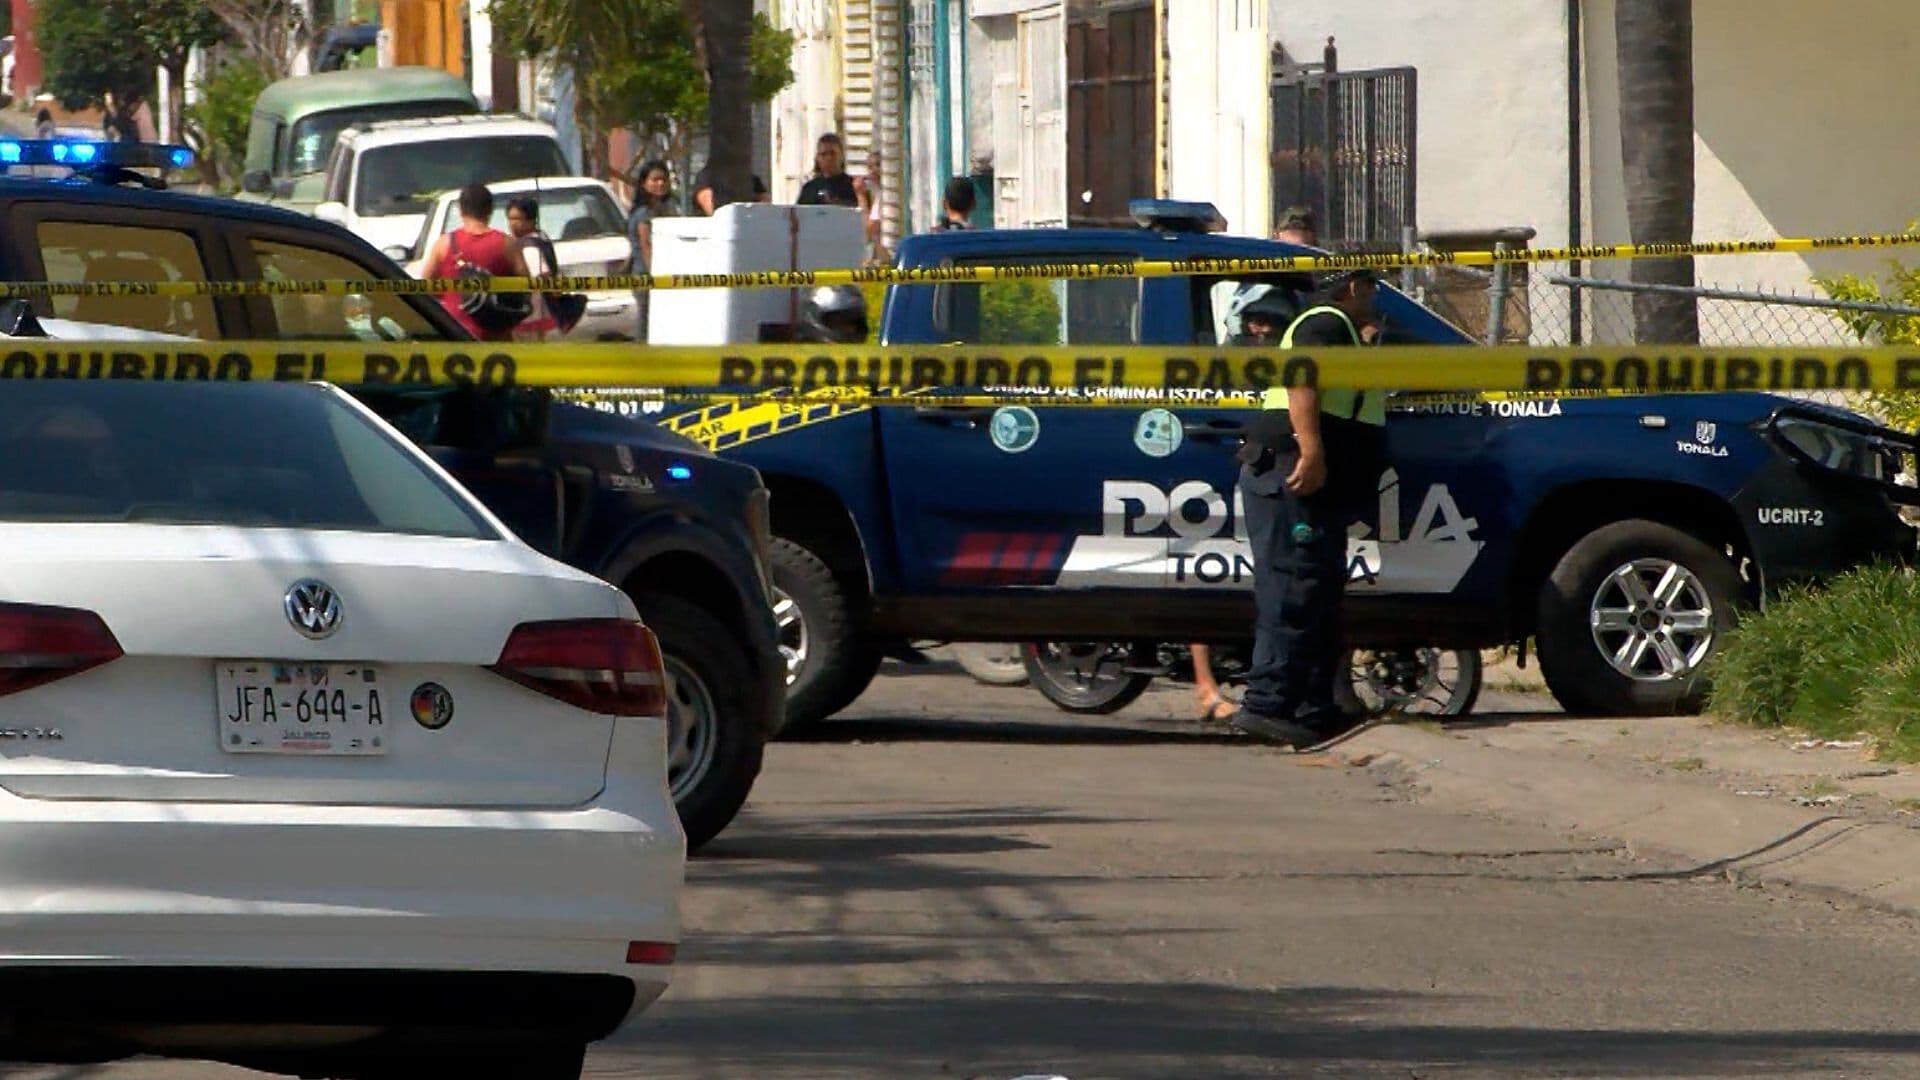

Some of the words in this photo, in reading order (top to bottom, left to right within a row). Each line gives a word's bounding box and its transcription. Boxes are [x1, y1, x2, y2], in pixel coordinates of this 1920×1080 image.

[361, 352, 518, 390] PASO
[718, 356, 1053, 390] PROHIBIDO
[1073, 356, 1126, 388] EL
[1162, 355, 1319, 390] PASO
[1525, 357, 1871, 390] PROHIBIDO
[1488, 398, 1562, 417] TONALÁ
[1102, 466, 1479, 543] POÍA
[1757, 507, 1825, 527] UCRIT-2
[1167, 545, 1380, 586] TONÁ
